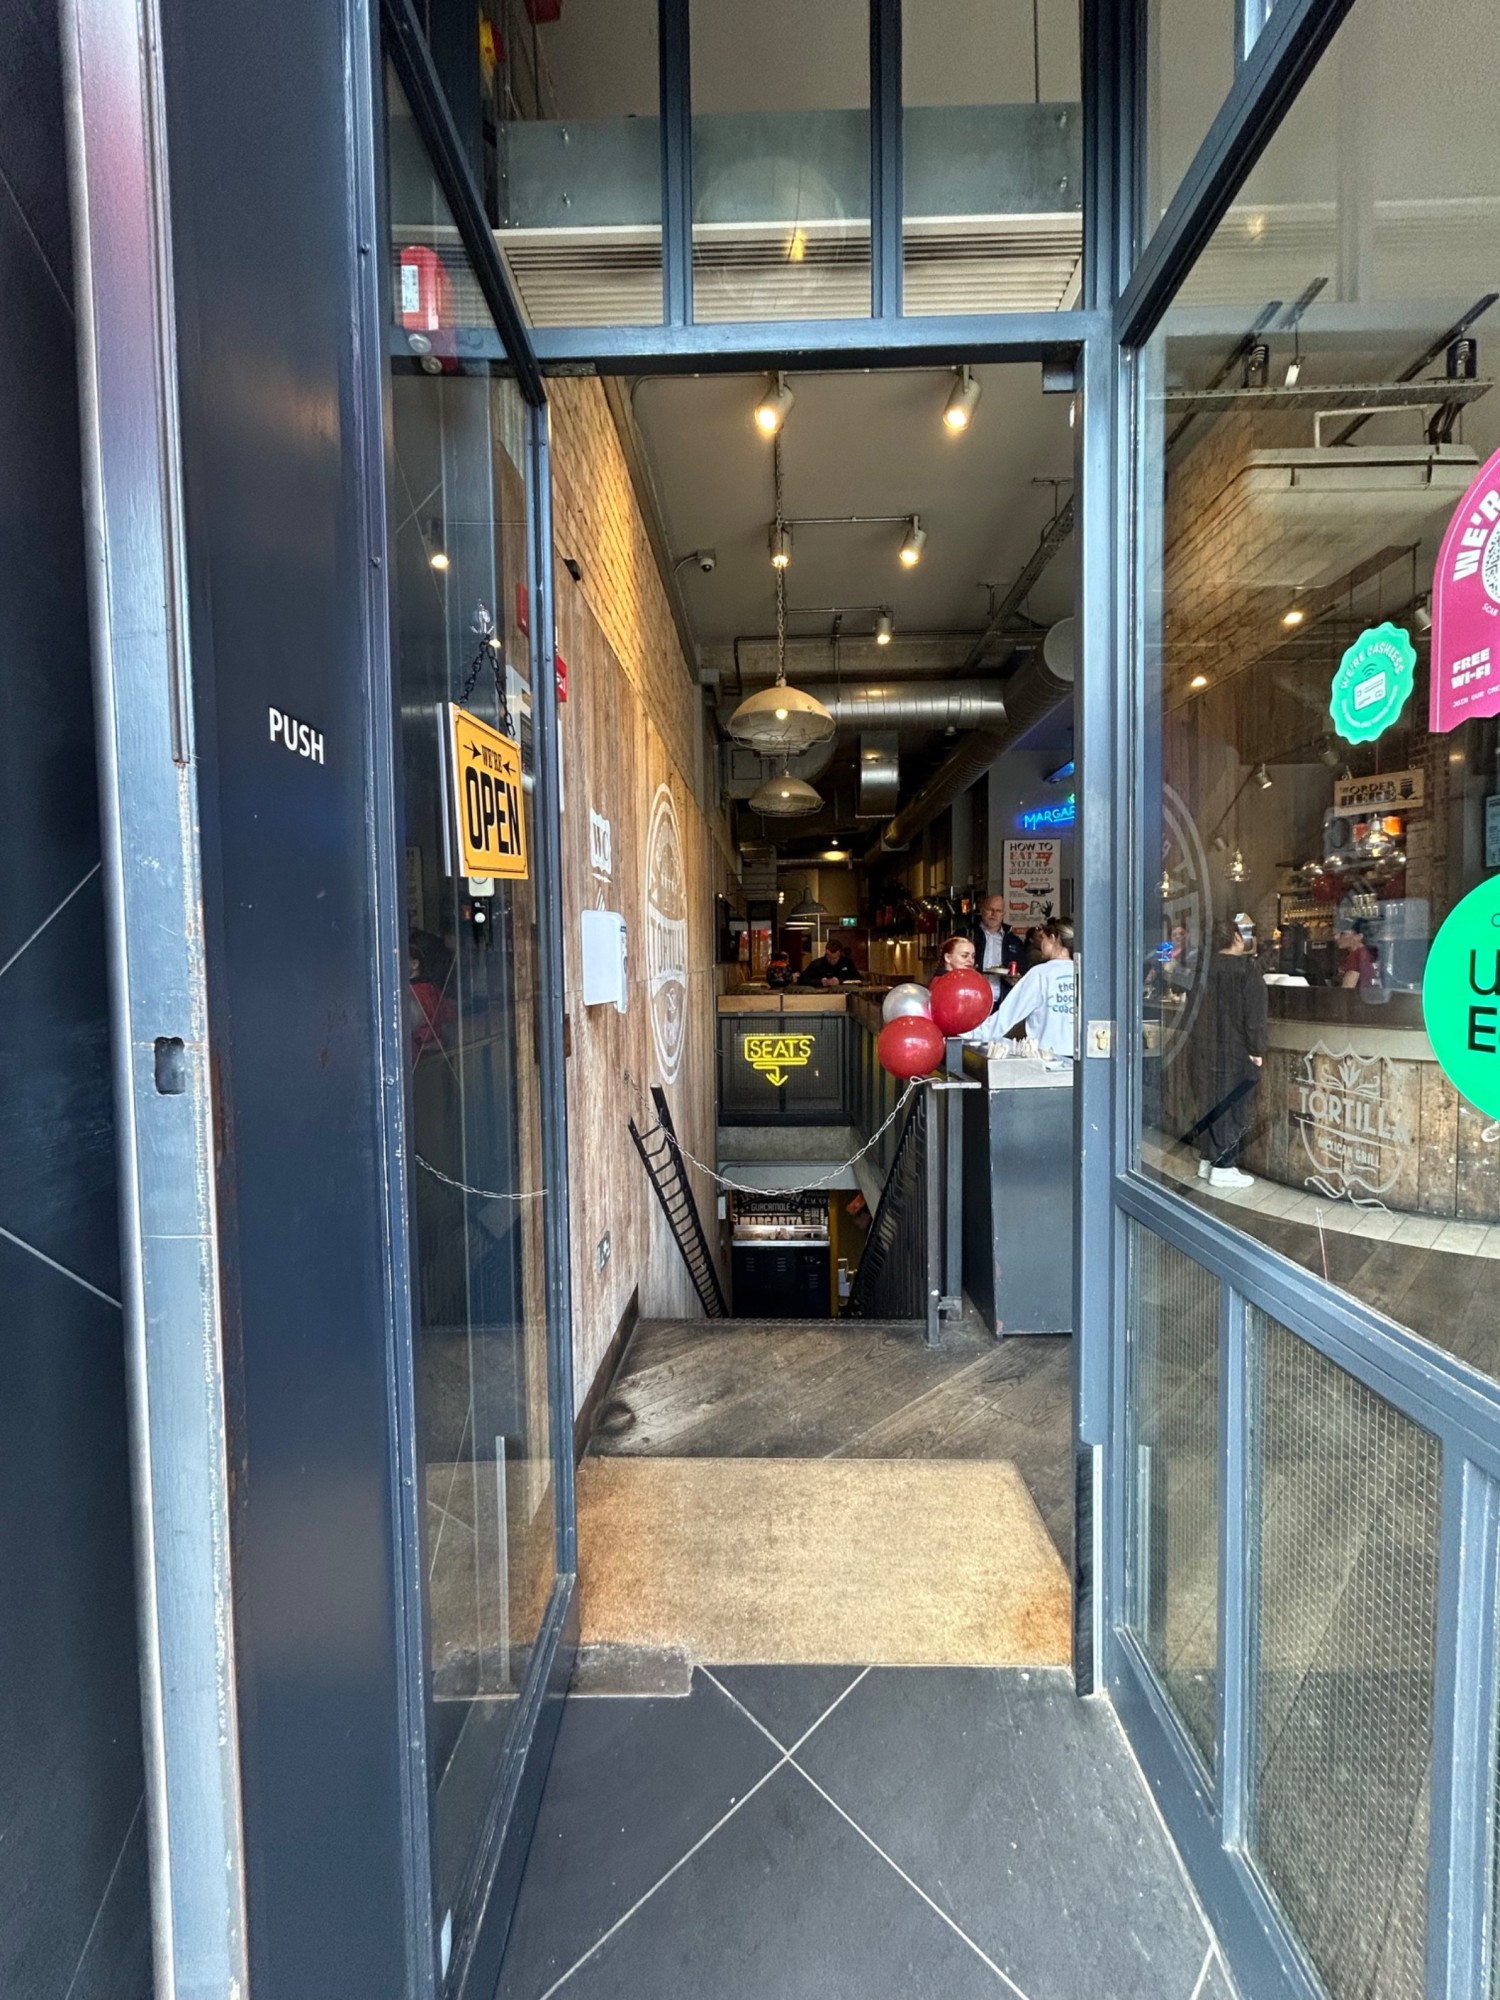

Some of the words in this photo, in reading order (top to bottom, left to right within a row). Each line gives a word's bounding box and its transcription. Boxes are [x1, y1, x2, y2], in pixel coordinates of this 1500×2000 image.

[1340, 651, 1366, 689] WE'RE
[1366, 642, 1405, 675] CASHLESS
[1452, 647, 1491, 675] FREE
[1451, 662, 1491, 689] WI-FI
[1471, 690, 1485, 701] OUR
[269, 707, 324, 765] PUSH
[481, 744, 502, 773] WE'RE
[1349, 780, 1395, 795] ORDER
[465, 766, 521, 856] OPEN
[1010, 842, 1035, 851] HOW
[1038, 842, 1053, 851] TO
[1010, 851, 1034, 860] EAT
[1010, 860, 1042, 868] YOUR
[1058, 982, 1075, 993] the
[750, 1039, 811, 1058] SEATS
[1299, 1087, 1409, 1145] TORTILLA
[1318, 1136, 1353, 1158] MEXICAN
[1355, 1149, 1380, 1168] GRILL
[750, 1203, 790, 1211] GUACAMOLE
[739, 1216, 803, 1225] MARGARITA
